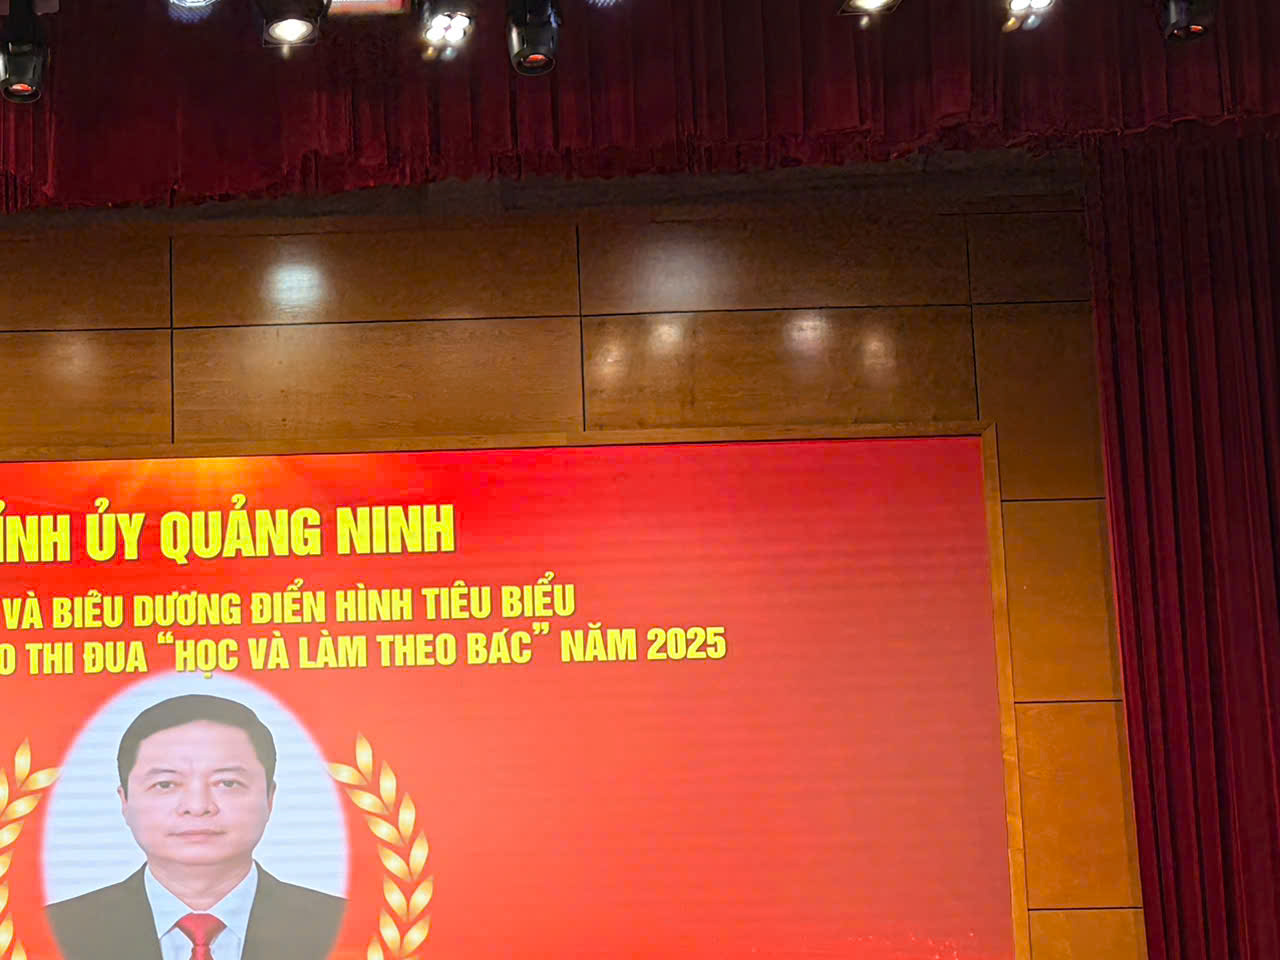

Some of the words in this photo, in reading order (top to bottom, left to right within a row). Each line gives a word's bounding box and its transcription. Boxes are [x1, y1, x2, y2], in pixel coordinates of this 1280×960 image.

[86, 497, 146, 561] ỦY
[160, 495, 321, 564] QUẢNG
[335, 503, 455, 556] NINH
[1, 591, 44, 630] VÀ
[132, 590, 242, 627] DƯƠNG
[250, 578, 326, 624] ĐIỂN
[335, 582, 413, 622] HÌNH
[421, 580, 491, 619] TIÊU
[501, 571, 576, 617] BIỂU
[24, 642, 74, 675] THI
[82, 640, 148, 673] ĐUA
[247, 630, 290, 670] VÀ
[298, 629, 368, 669] LÀM
[375, 633, 457, 667] THEO
[560, 622, 637, 662] NĂM
[646, 626, 727, 660] 2025
